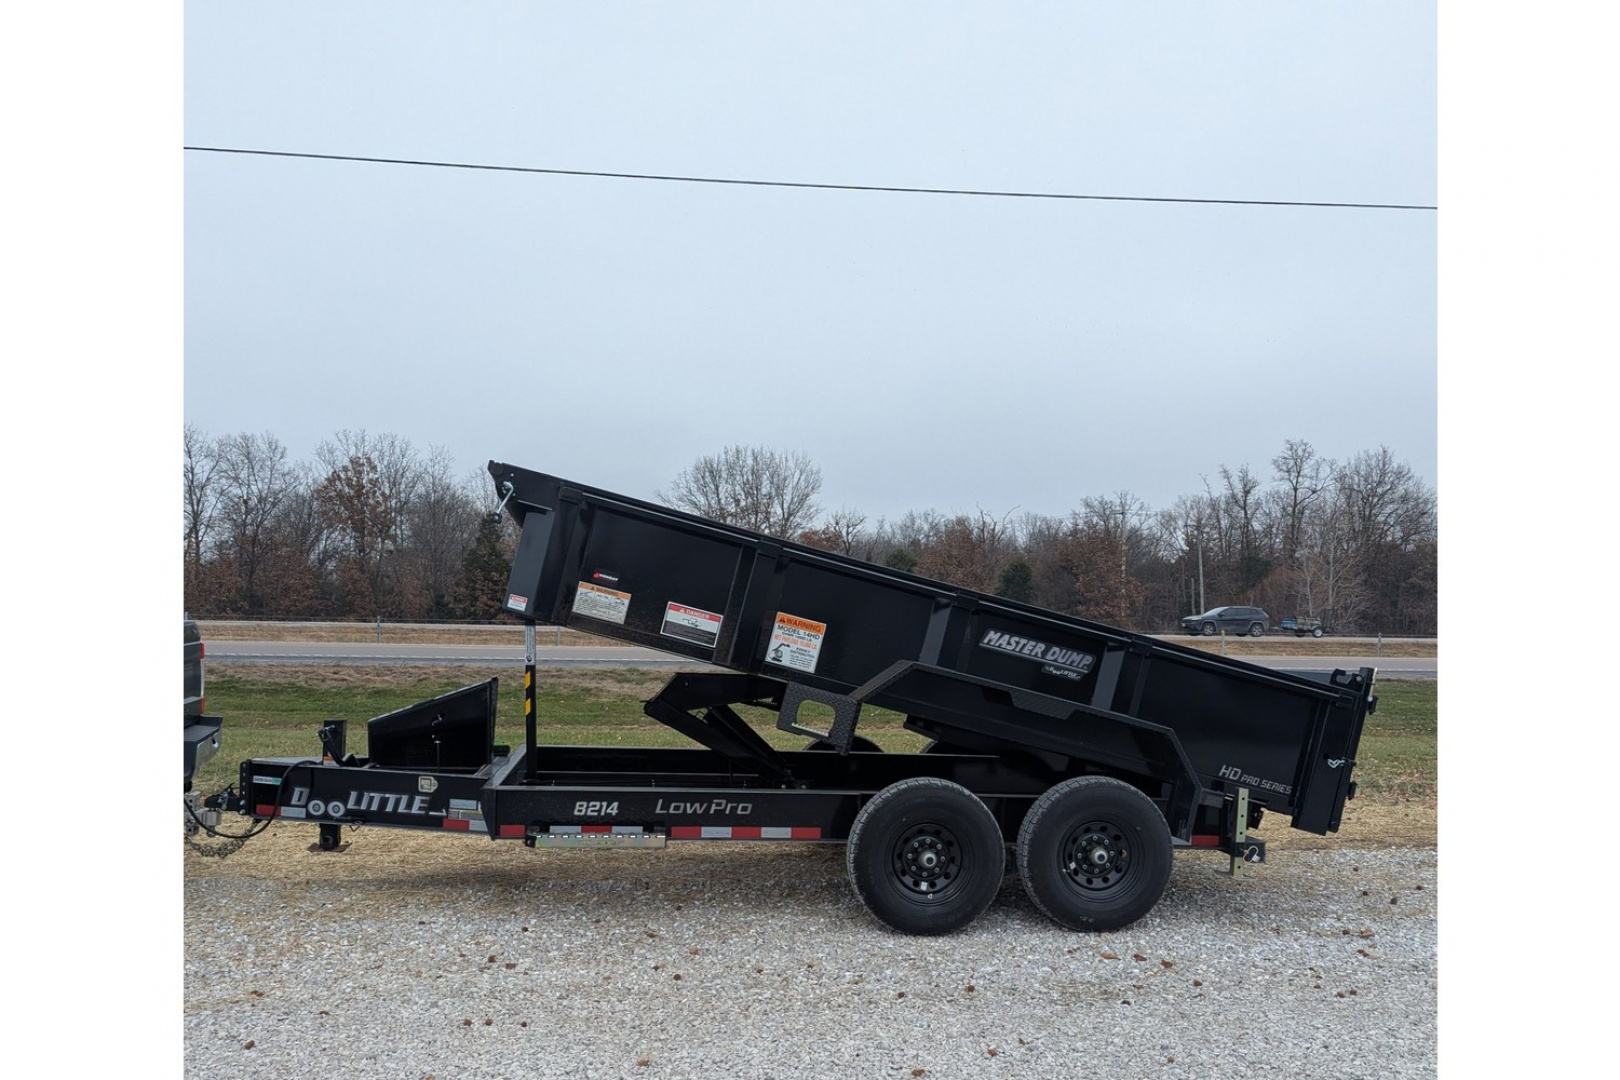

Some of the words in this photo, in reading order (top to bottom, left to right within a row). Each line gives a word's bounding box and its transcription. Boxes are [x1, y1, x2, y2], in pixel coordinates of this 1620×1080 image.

[686, 609, 710, 620] DANGER
[777, 624, 801, 635] MODEL
[786, 617, 821, 632] WARNING
[983, 630, 1046, 657] MASTER
[1218, 764, 1242, 780] HD
[1240, 773, 1260, 786] PRO
[1260, 780, 1293, 795] SERIES
[573, 801, 619, 816] 8214
